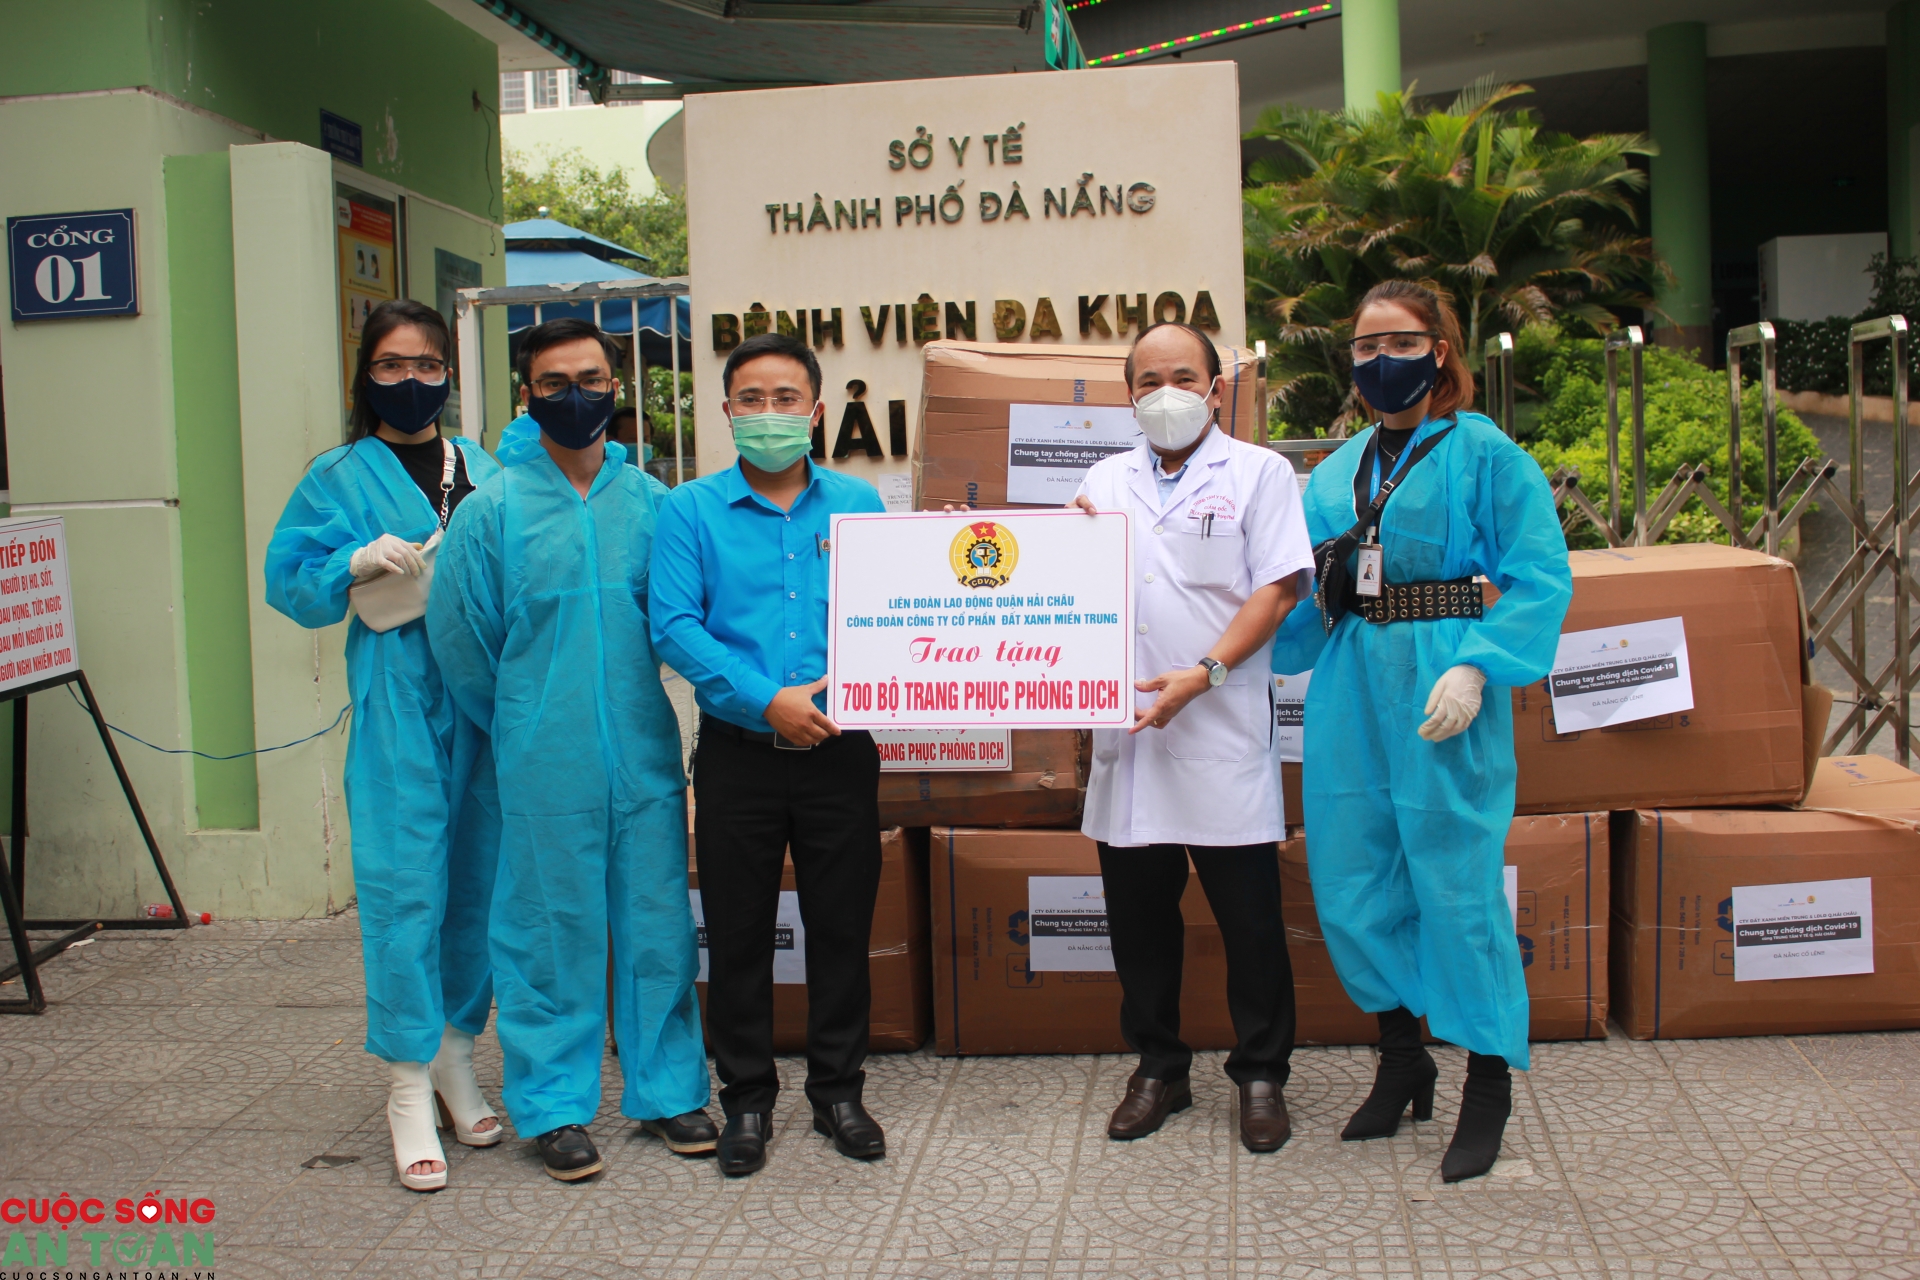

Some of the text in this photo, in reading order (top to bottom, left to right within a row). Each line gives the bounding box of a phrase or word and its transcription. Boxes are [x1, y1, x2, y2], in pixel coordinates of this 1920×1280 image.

[888, 121, 1026, 171] SỞ Y TẾ
[765, 172, 1157, 234] THÀNH PHỐ ĐÀ NẴNG
[27, 225, 115, 248] CỔNG
[35, 251, 112, 303] 01
[993, 297, 1062, 340] ĐA
[1078, 290, 1221, 335] KHOA
[1074, 379, 1087, 403] DỊCH
[1014, 449, 1039, 458] Chung
[1041, 451, 1053, 459] tay
[1055, 450, 1079, 460] chống
[1081, 451, 1097, 460] dịch
[0, 535, 57, 569] TIẾP ĐÓN
[0, 573, 20, 595] NGƯỜI
[21, 575, 29, 594] BỊ
[32, 597, 44, 616] TỨC
[45, 595, 62, 615] NGỰC
[888, 592, 1075, 610] LIÊN ĐOÀN LAO ĐỘNG QUẬN HẢI CHÂU
[847, 610, 1118, 628] CÔNG ĐOÀN CÔNG TY CỔ PHẦN ĐẤT XANH MIỀN TRUNG
[26, 624, 45, 647] NGƯỜI
[45, 622, 54, 641] VÀ
[55, 619, 64, 638] CÓ
[0, 648, 72, 682] GƯỜI NGHI NHIỄM COVID
[909, 637, 1063, 668] Trao tặng
[1555, 662, 1674, 687] Chung tay chống dịch Covid-19
[842, 673, 1119, 718] 700 BỘ TRANG PHỤC PHÒNG DỊCH
[877, 738, 1004, 765] RANG PHỤC PHÒNG DỊCH
[1035, 920, 1059, 928] Chung
[1075, 920, 1098, 928] chống
[1766, 928, 1779, 936] tay
[1780, 926, 1804, 935] chống
[1805, 925, 1822, 933] dịch
[1824, 922, 1858, 931] Covid-19
